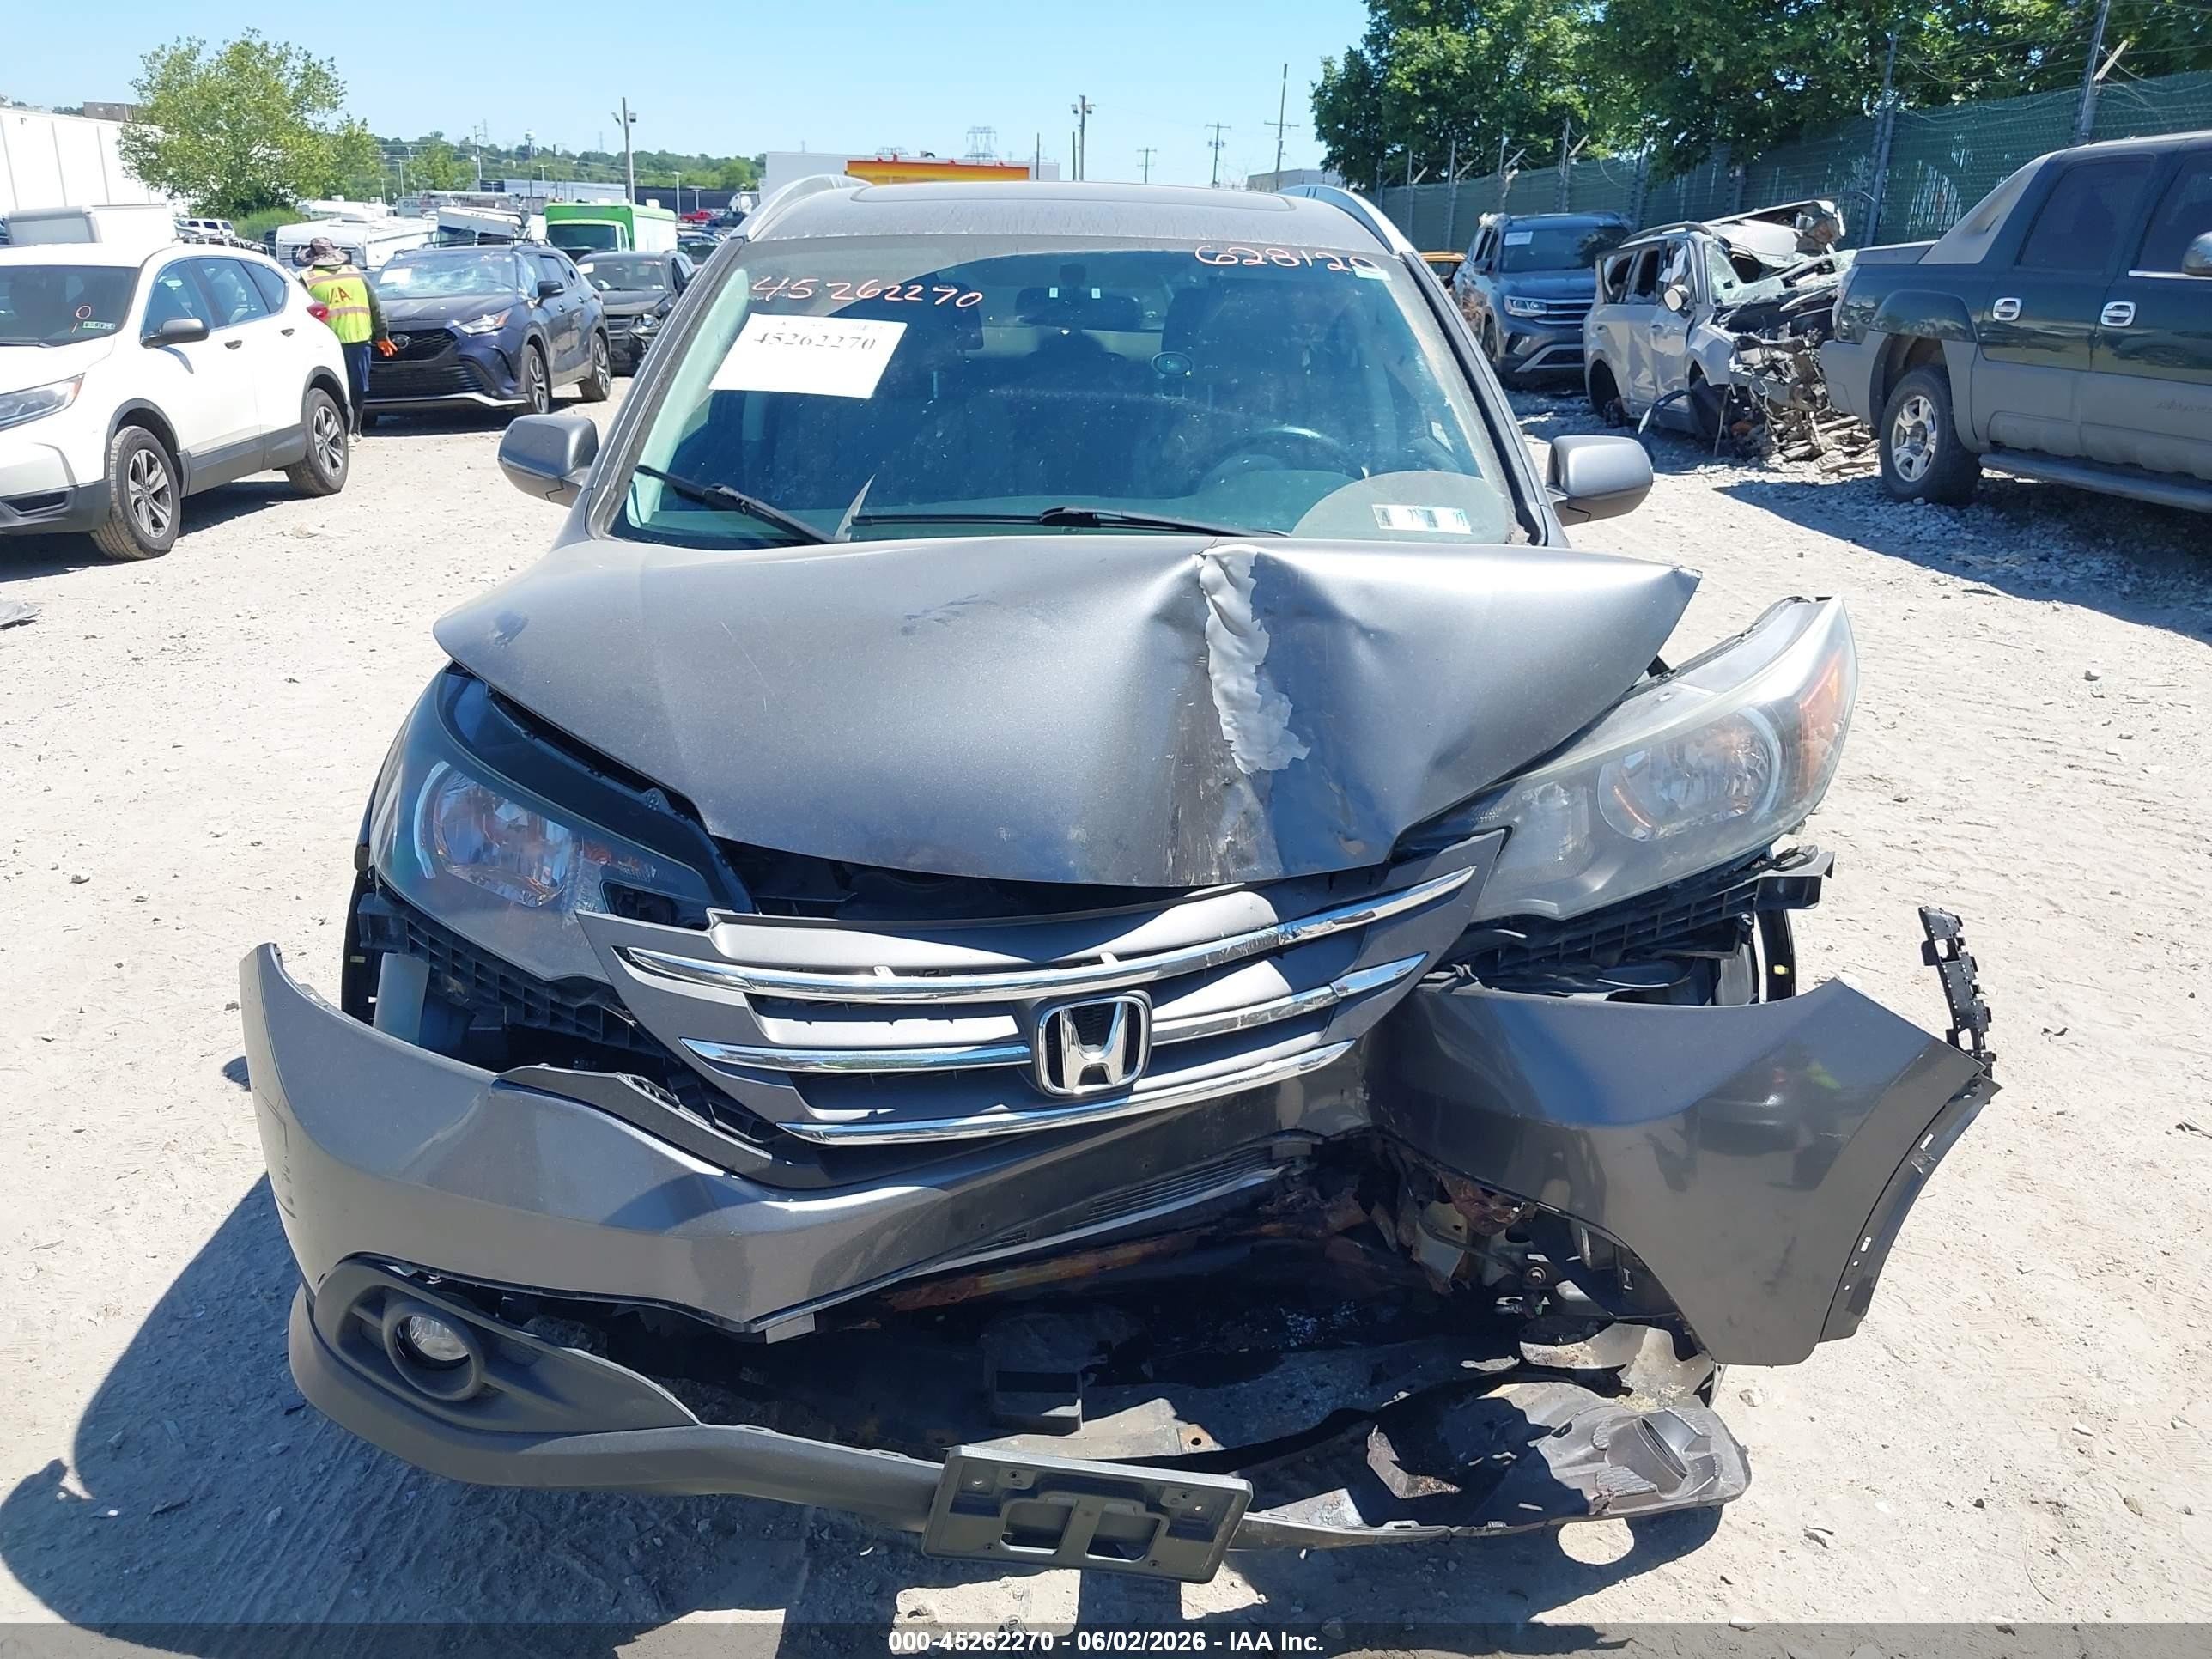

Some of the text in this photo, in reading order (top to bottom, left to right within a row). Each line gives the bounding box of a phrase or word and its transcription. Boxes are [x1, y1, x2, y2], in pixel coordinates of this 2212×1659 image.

[1194, 245, 1382, 274] 628120
[752, 276, 984, 308] 45262270
[754, 331, 877, 350] 45262270
